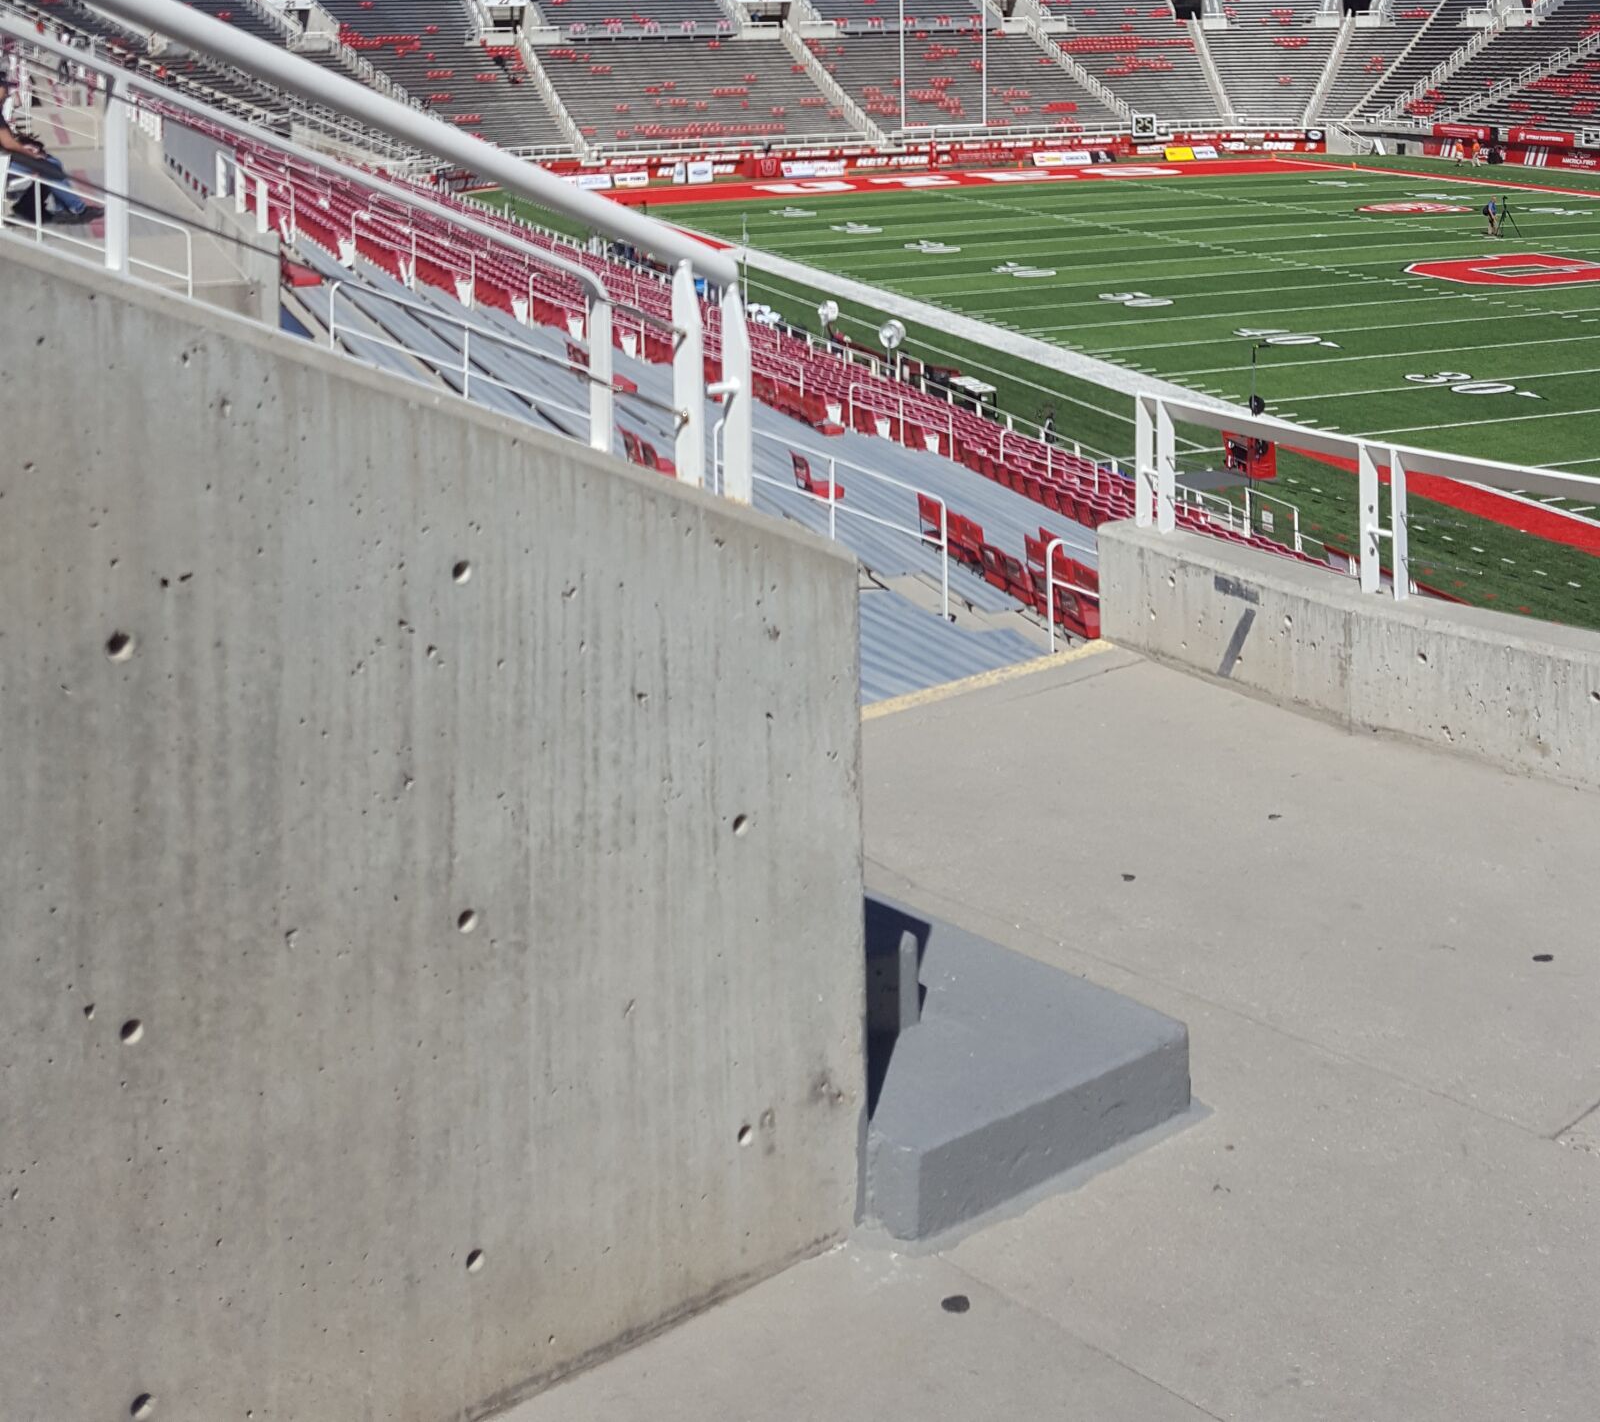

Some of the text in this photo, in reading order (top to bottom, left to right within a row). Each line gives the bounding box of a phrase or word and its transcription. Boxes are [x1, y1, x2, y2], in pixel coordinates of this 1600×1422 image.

[1137, 118, 1153, 133] 25
[1562, 157, 1597, 166] AMERICA FIRST
[1403, 371, 1517, 395] 30
